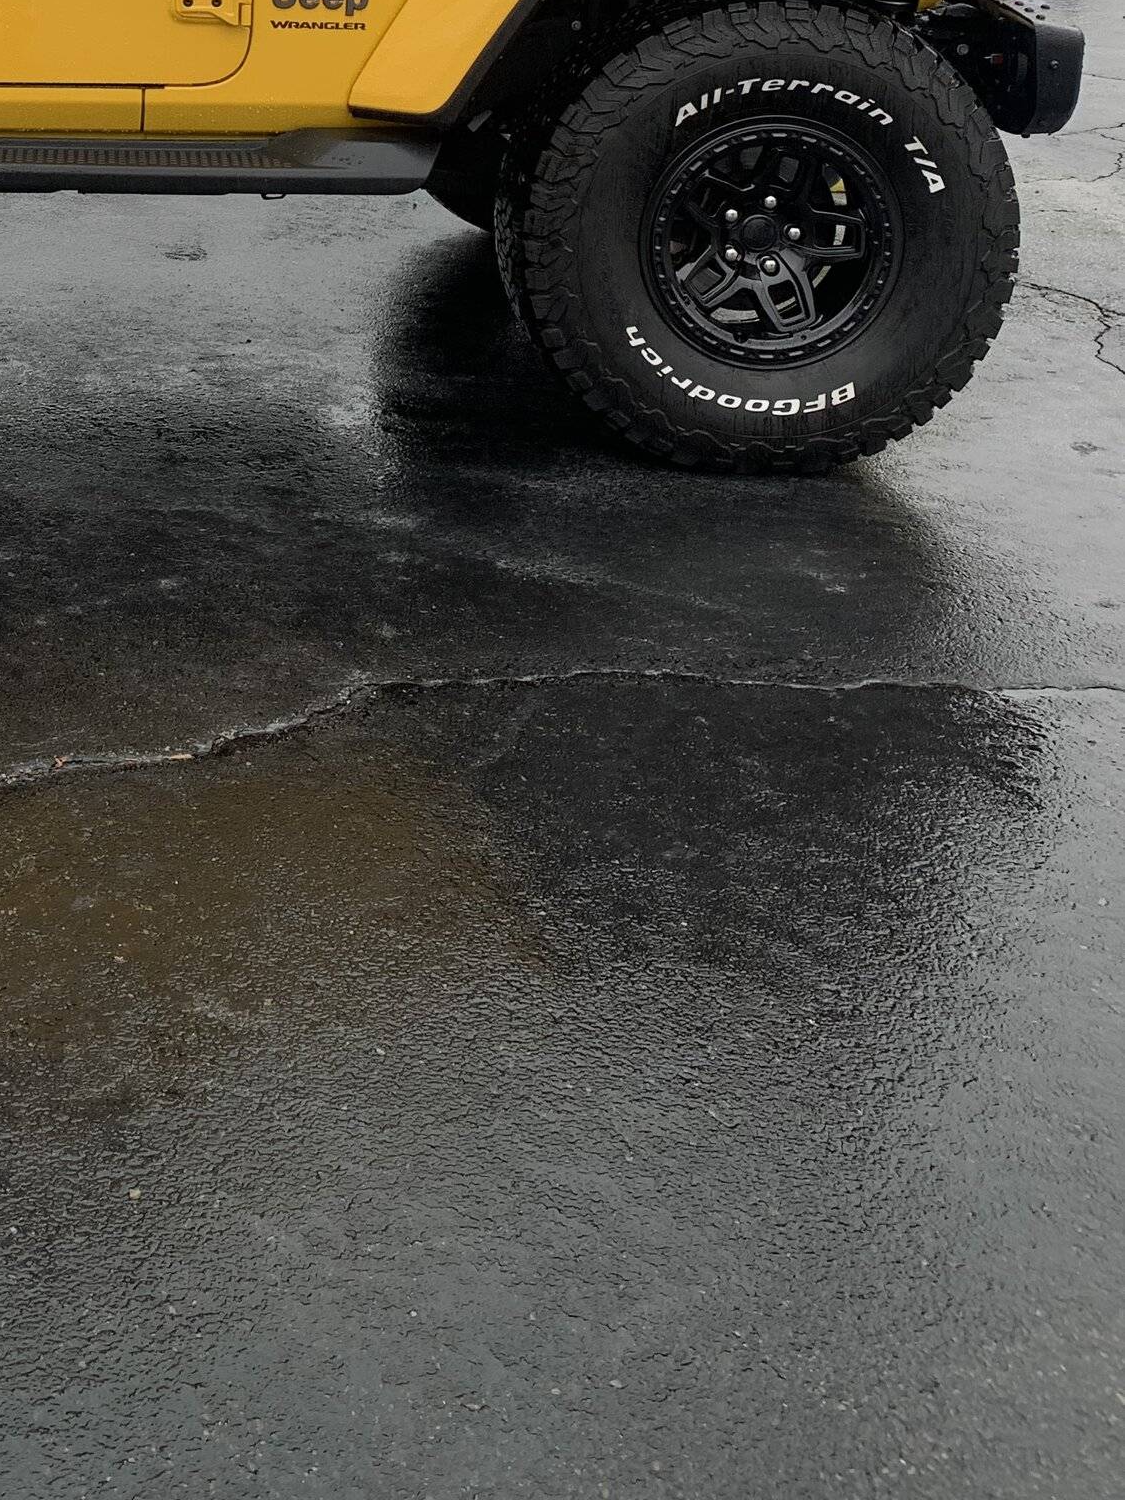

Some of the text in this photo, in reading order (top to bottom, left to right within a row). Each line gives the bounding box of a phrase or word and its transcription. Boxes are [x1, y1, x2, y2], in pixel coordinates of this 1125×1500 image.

[270, 20, 366, 31] WRANGLER
[675, 77, 946, 193] All-Terrain T/A
[625, 325, 856, 416] BFGoodrich
